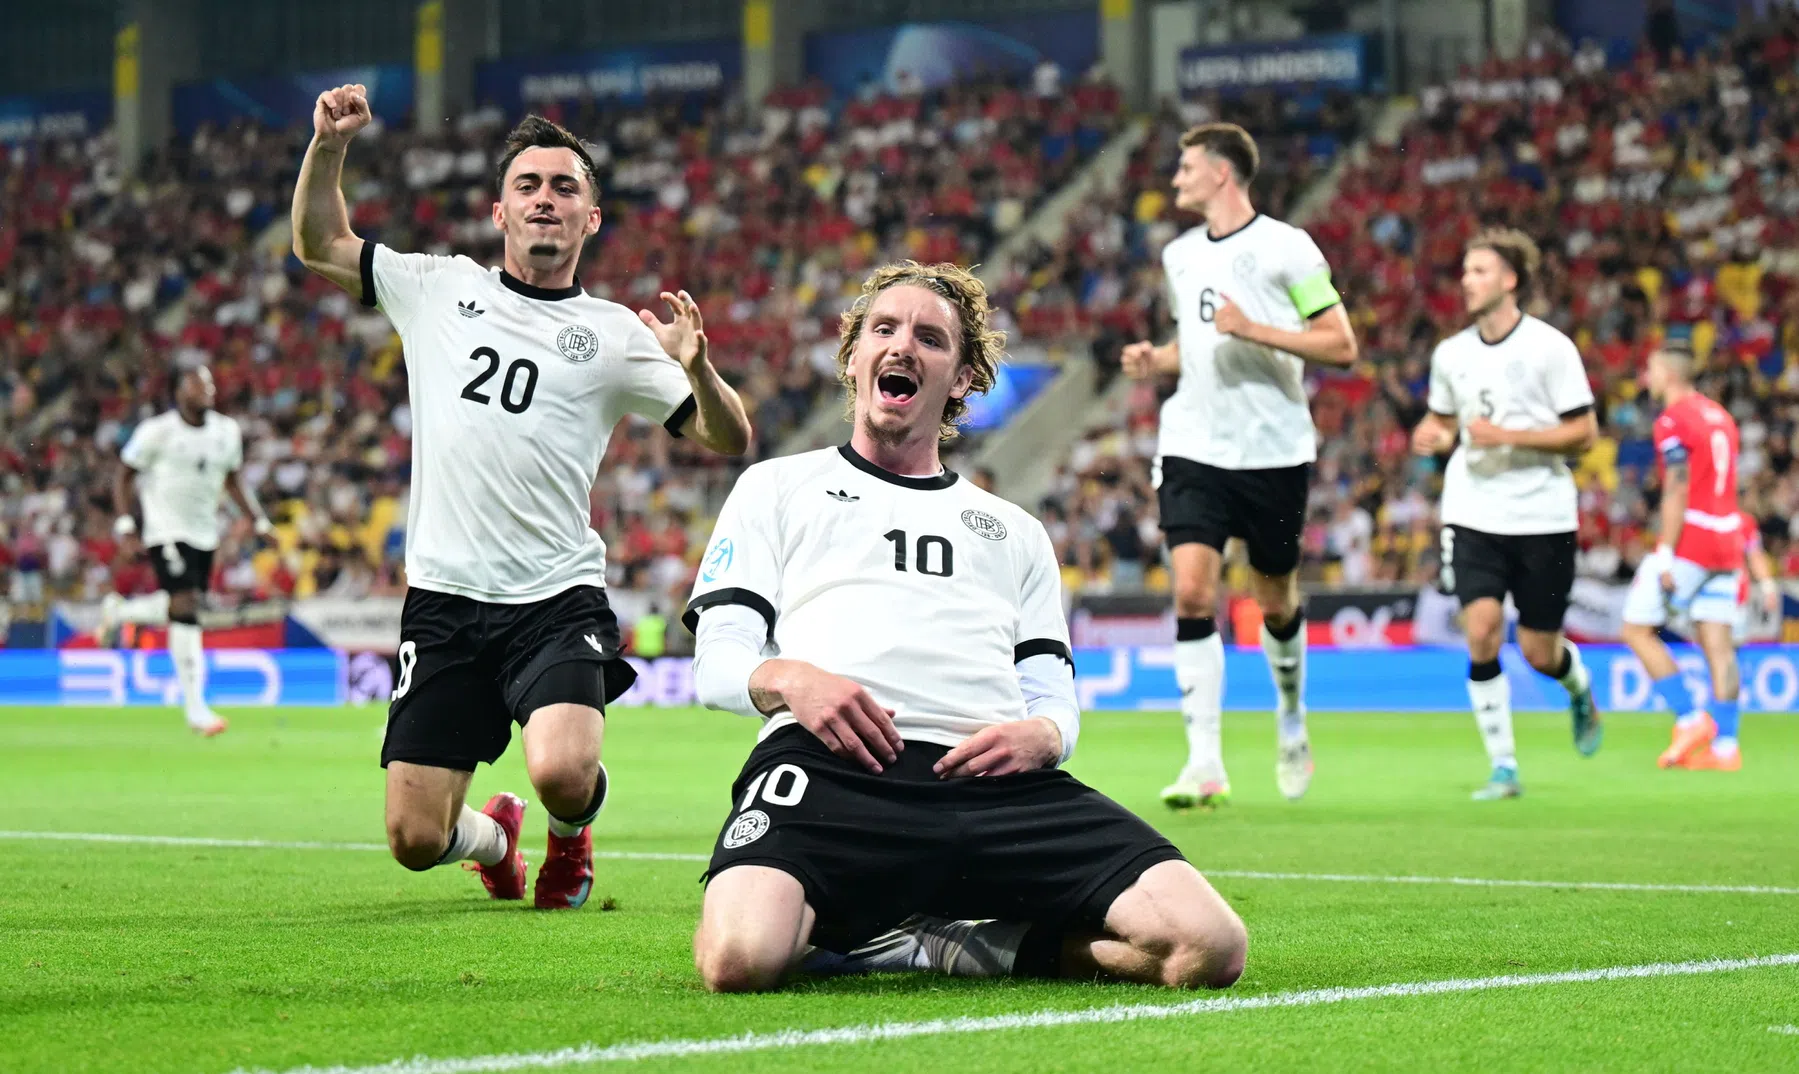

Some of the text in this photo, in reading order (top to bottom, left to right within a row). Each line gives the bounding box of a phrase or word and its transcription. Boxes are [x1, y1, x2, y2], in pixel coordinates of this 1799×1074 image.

[1199, 288, 1216, 323] 6
[460, 346, 539, 414] 20
[1479, 389, 1494, 418] 5
[1709, 430, 1730, 497] 9
[883, 529, 954, 578] 10
[739, 763, 810, 813] 10
